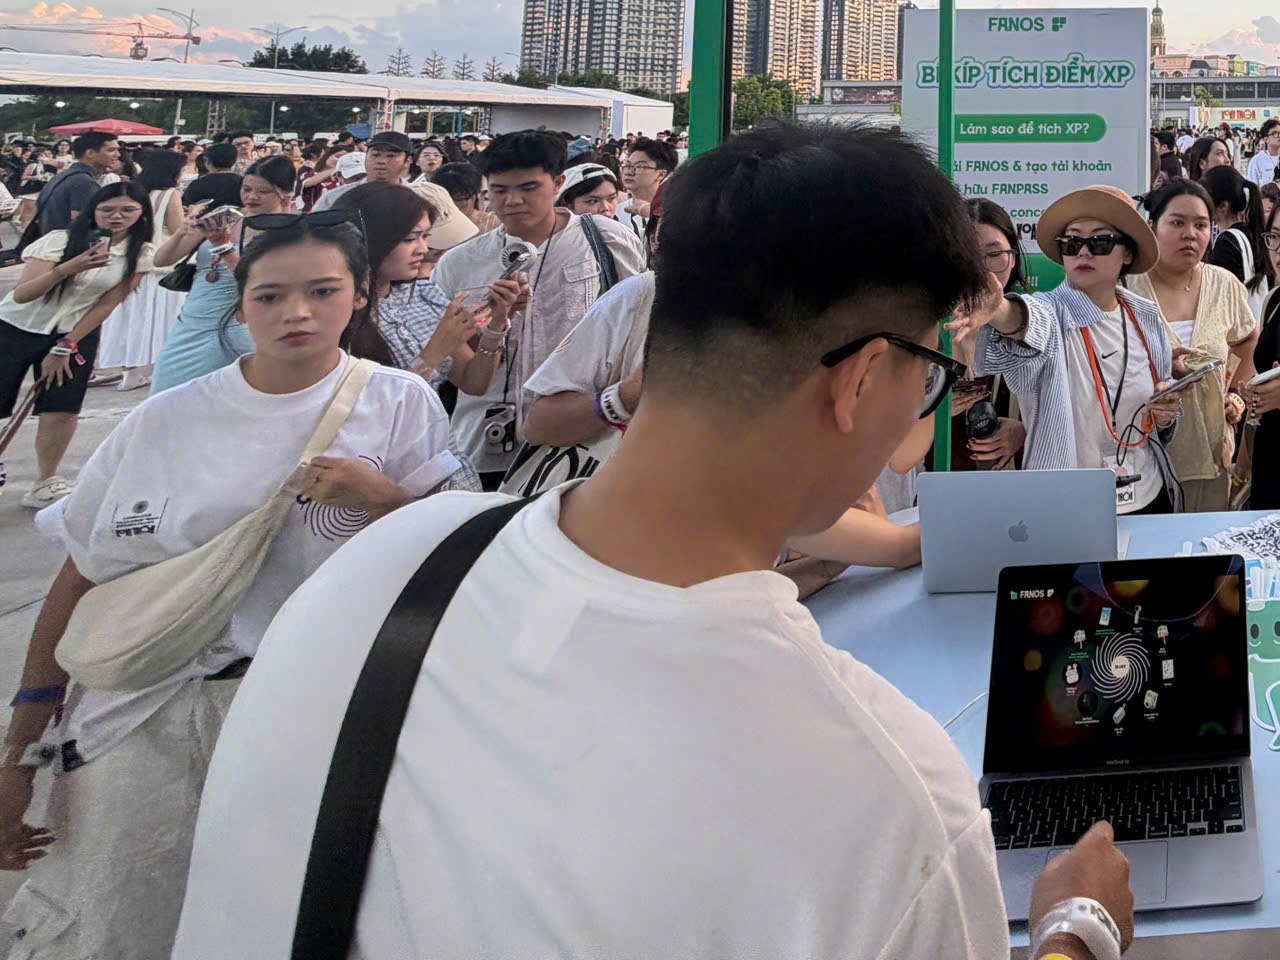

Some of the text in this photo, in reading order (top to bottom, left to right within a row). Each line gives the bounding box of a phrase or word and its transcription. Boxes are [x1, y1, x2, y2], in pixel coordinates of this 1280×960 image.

[988, 17, 1045, 32] FANOS
[988, 61, 1038, 84] TÍCH
[1045, 56, 1096, 84] ĐIỂM
[1103, 65, 1130, 84] XP
[960, 121, 1090, 135] Làm sao để tích XP?
[966, 161, 1009, 172] FANOS
[1013, 161, 1022, 172] &
[1026, 161, 1048, 175] tạo
[1051, 160, 1069, 172] tài
[1073, 160, 1112, 172] khoản
[992, 183, 1049, 195] FANPASS
